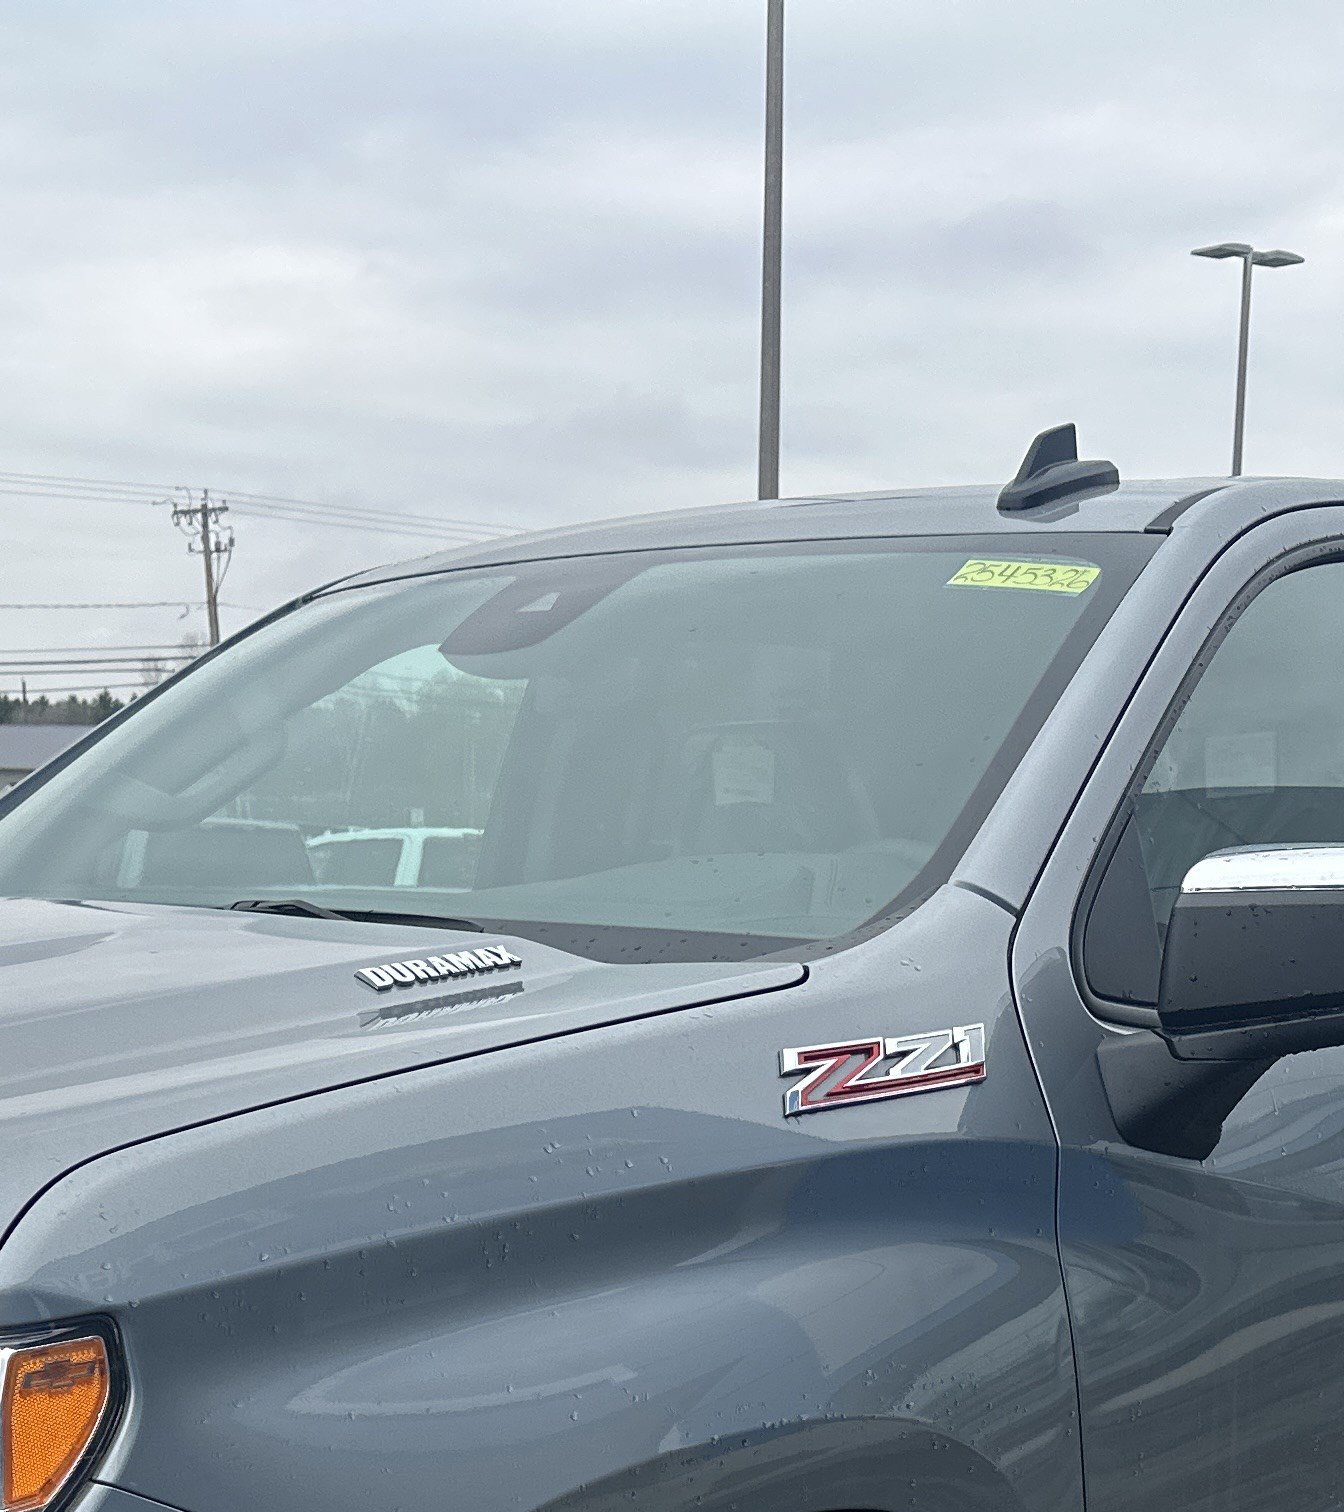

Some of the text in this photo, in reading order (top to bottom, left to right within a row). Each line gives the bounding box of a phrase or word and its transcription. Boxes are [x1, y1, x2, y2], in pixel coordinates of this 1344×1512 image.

[953, 562, 1091, 588] 2545326
[355, 944, 523, 991] DURAMAX
[779, 1022, 987, 1117] Z71
